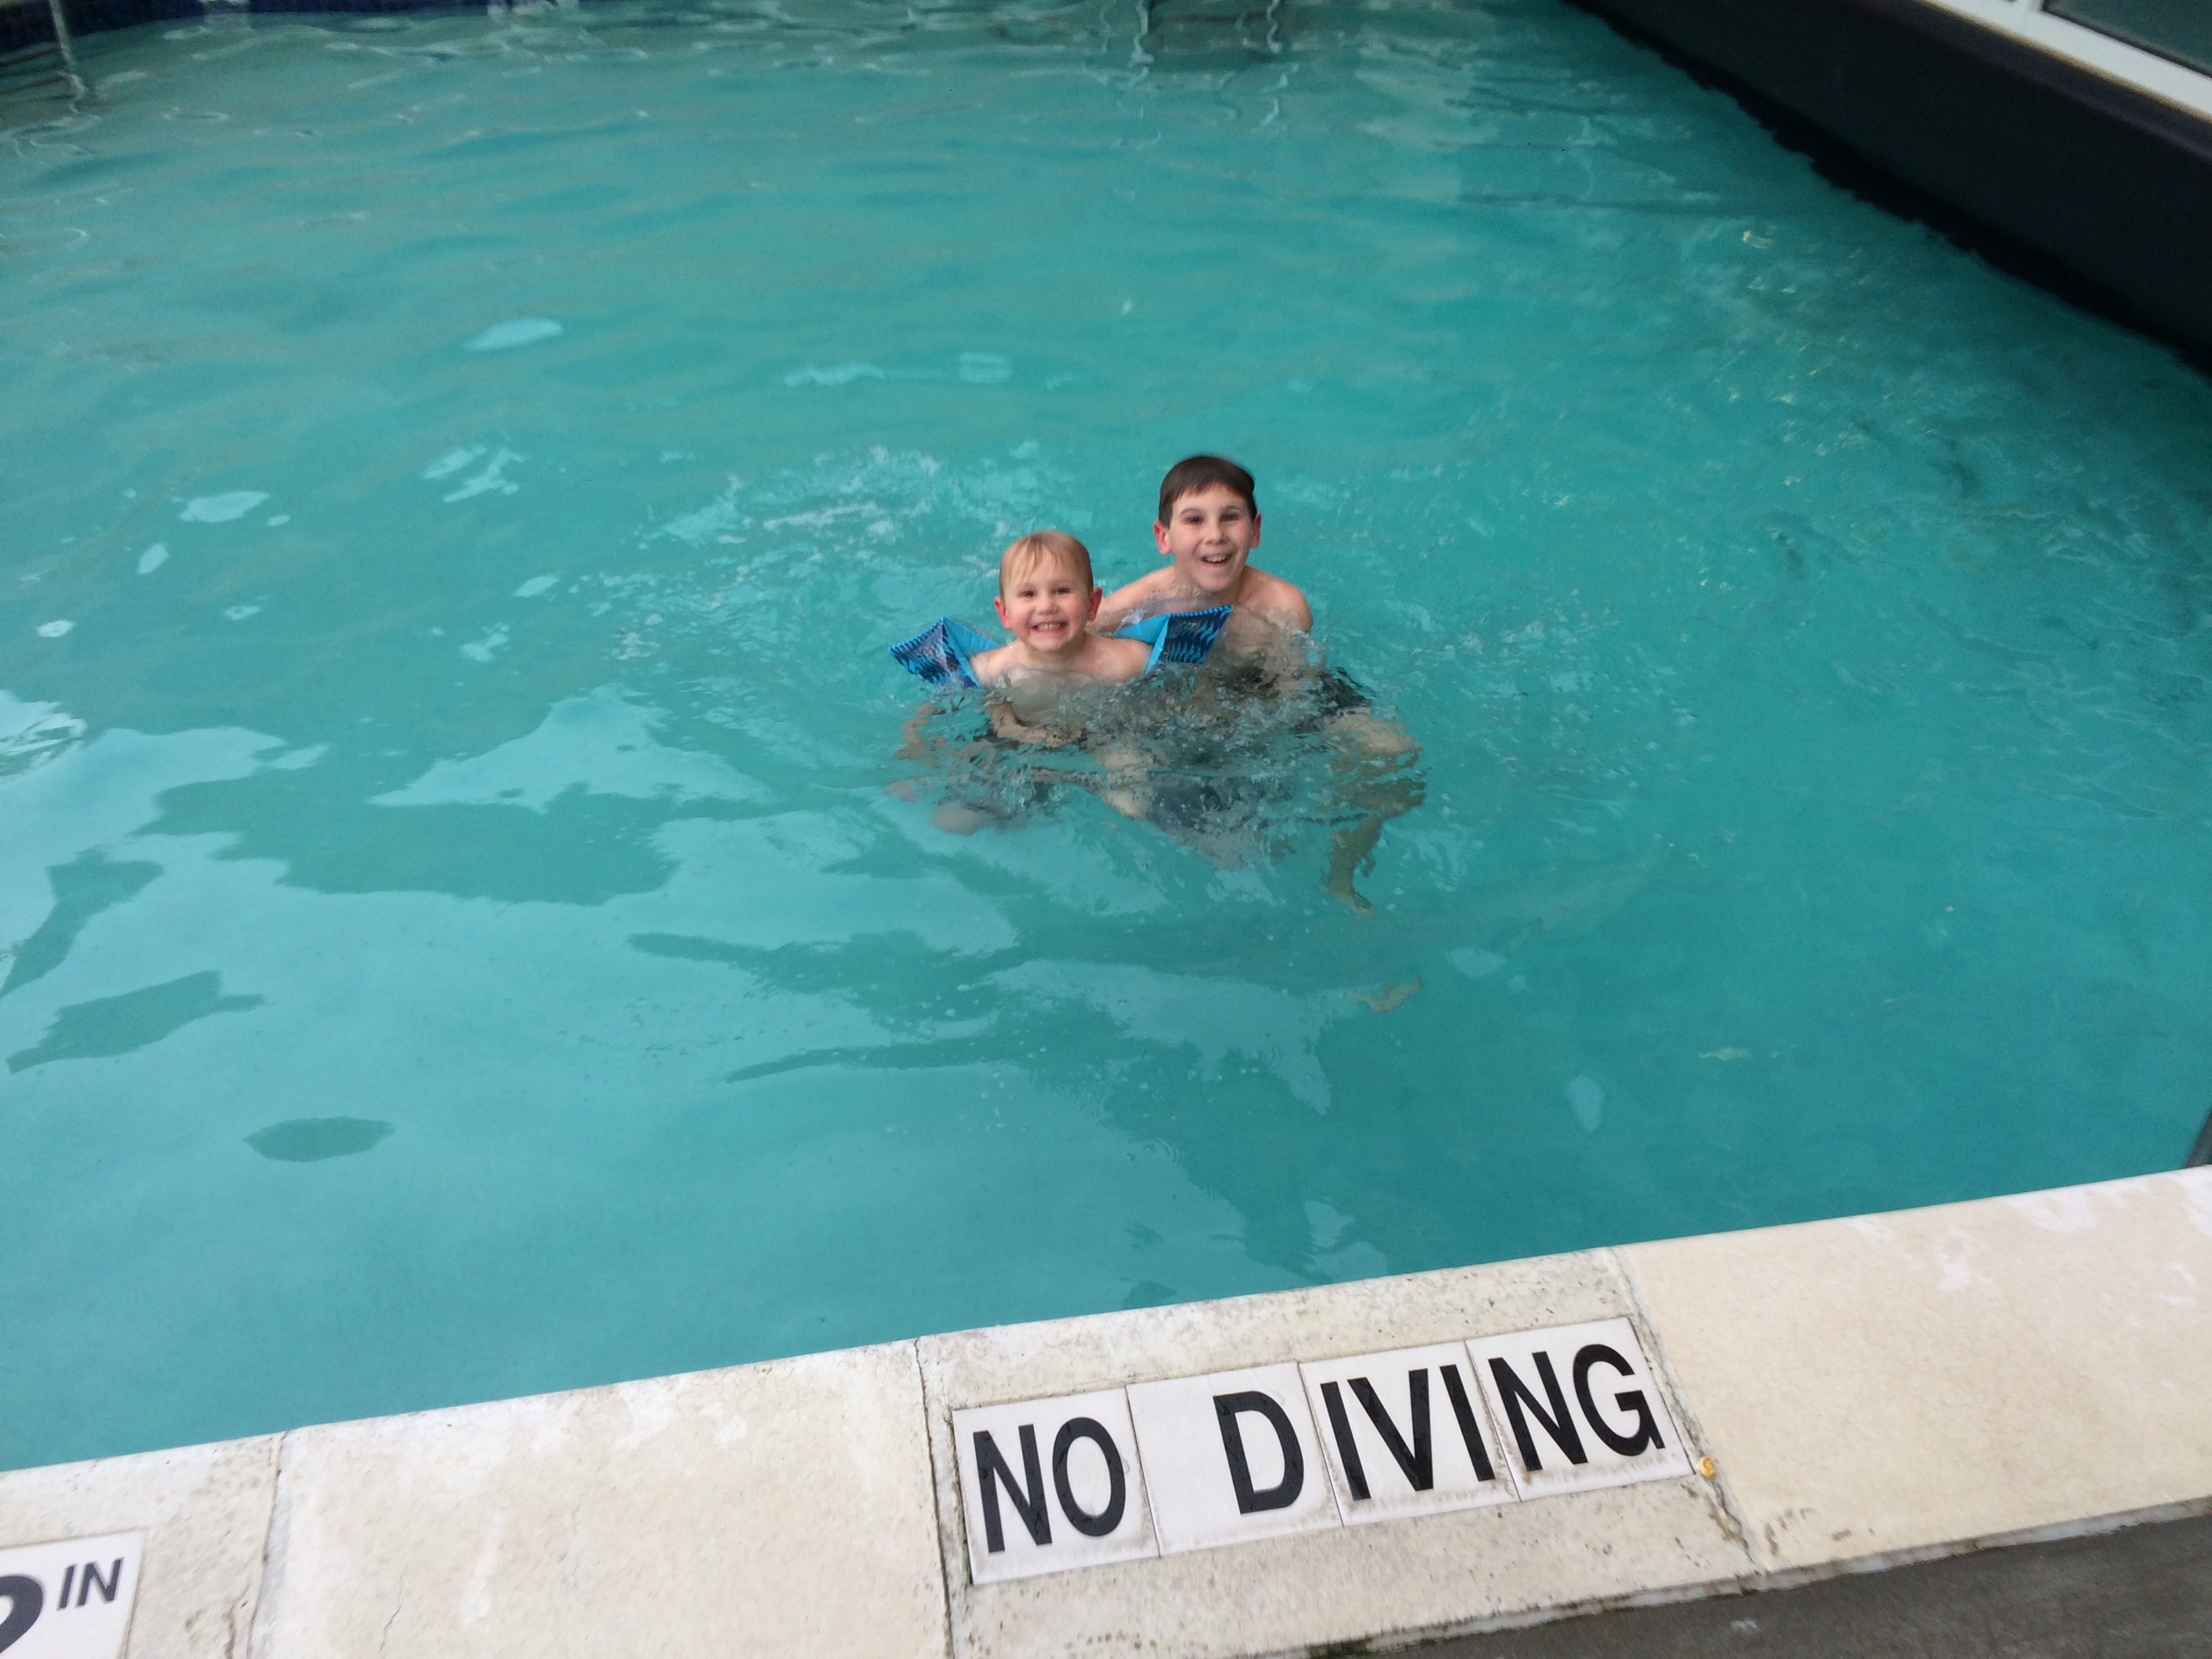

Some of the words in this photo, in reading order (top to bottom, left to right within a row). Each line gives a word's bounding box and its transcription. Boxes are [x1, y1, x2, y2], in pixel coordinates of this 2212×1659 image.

[972, 1416, 1126, 1553] NO
[1212, 1343, 1665, 1515] DIVING
[57, 1557, 124, 1611] IN
